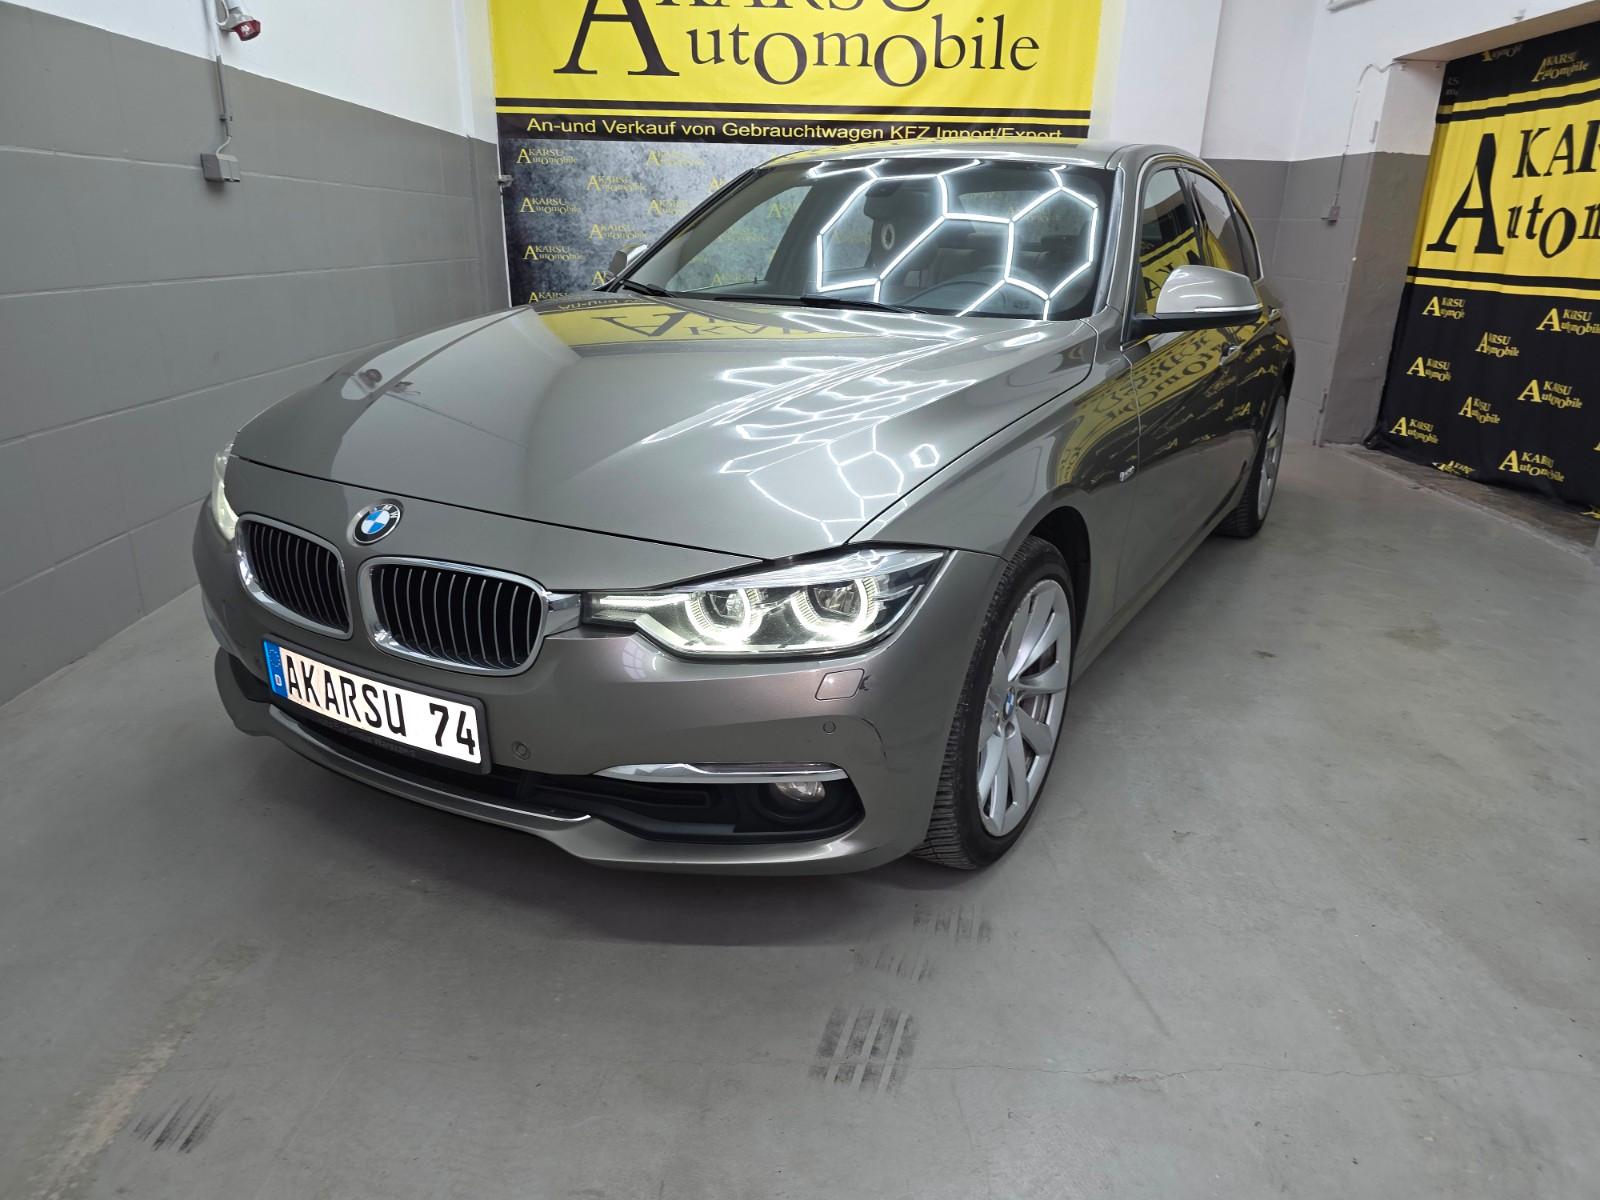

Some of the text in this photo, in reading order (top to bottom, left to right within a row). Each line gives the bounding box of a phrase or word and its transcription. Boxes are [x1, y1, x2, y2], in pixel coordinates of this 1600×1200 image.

[527, 117, 597, 133] An-und
[602, 119, 677, 135] Verkauf
[681, 124, 716, 136] von
[722, 122, 884, 142] Gebrauchtwagen
[890, 125, 930, 139] KFZ
[286, 654, 407, 737] AKARSU
[429, 702, 476, 756] 74
